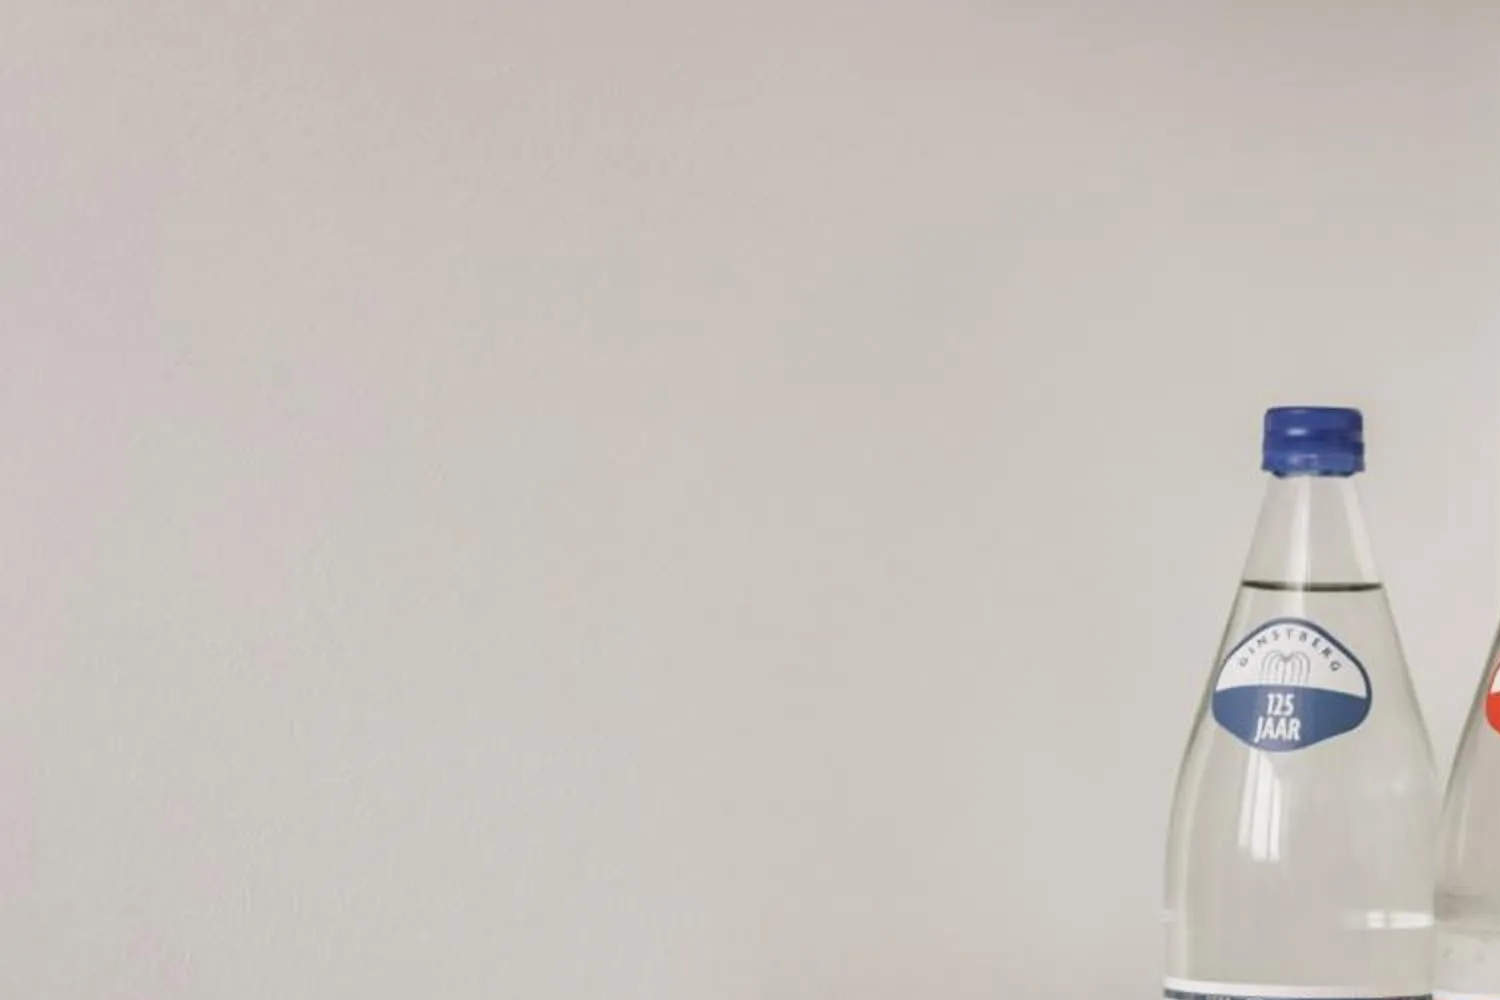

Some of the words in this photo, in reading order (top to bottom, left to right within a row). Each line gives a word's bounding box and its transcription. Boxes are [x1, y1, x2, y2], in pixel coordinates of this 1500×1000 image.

[1238, 628, 1342, 672] GINSTBERG
[1266, 693, 1295, 716] 125
[1253, 716, 1301, 744] JAAR
